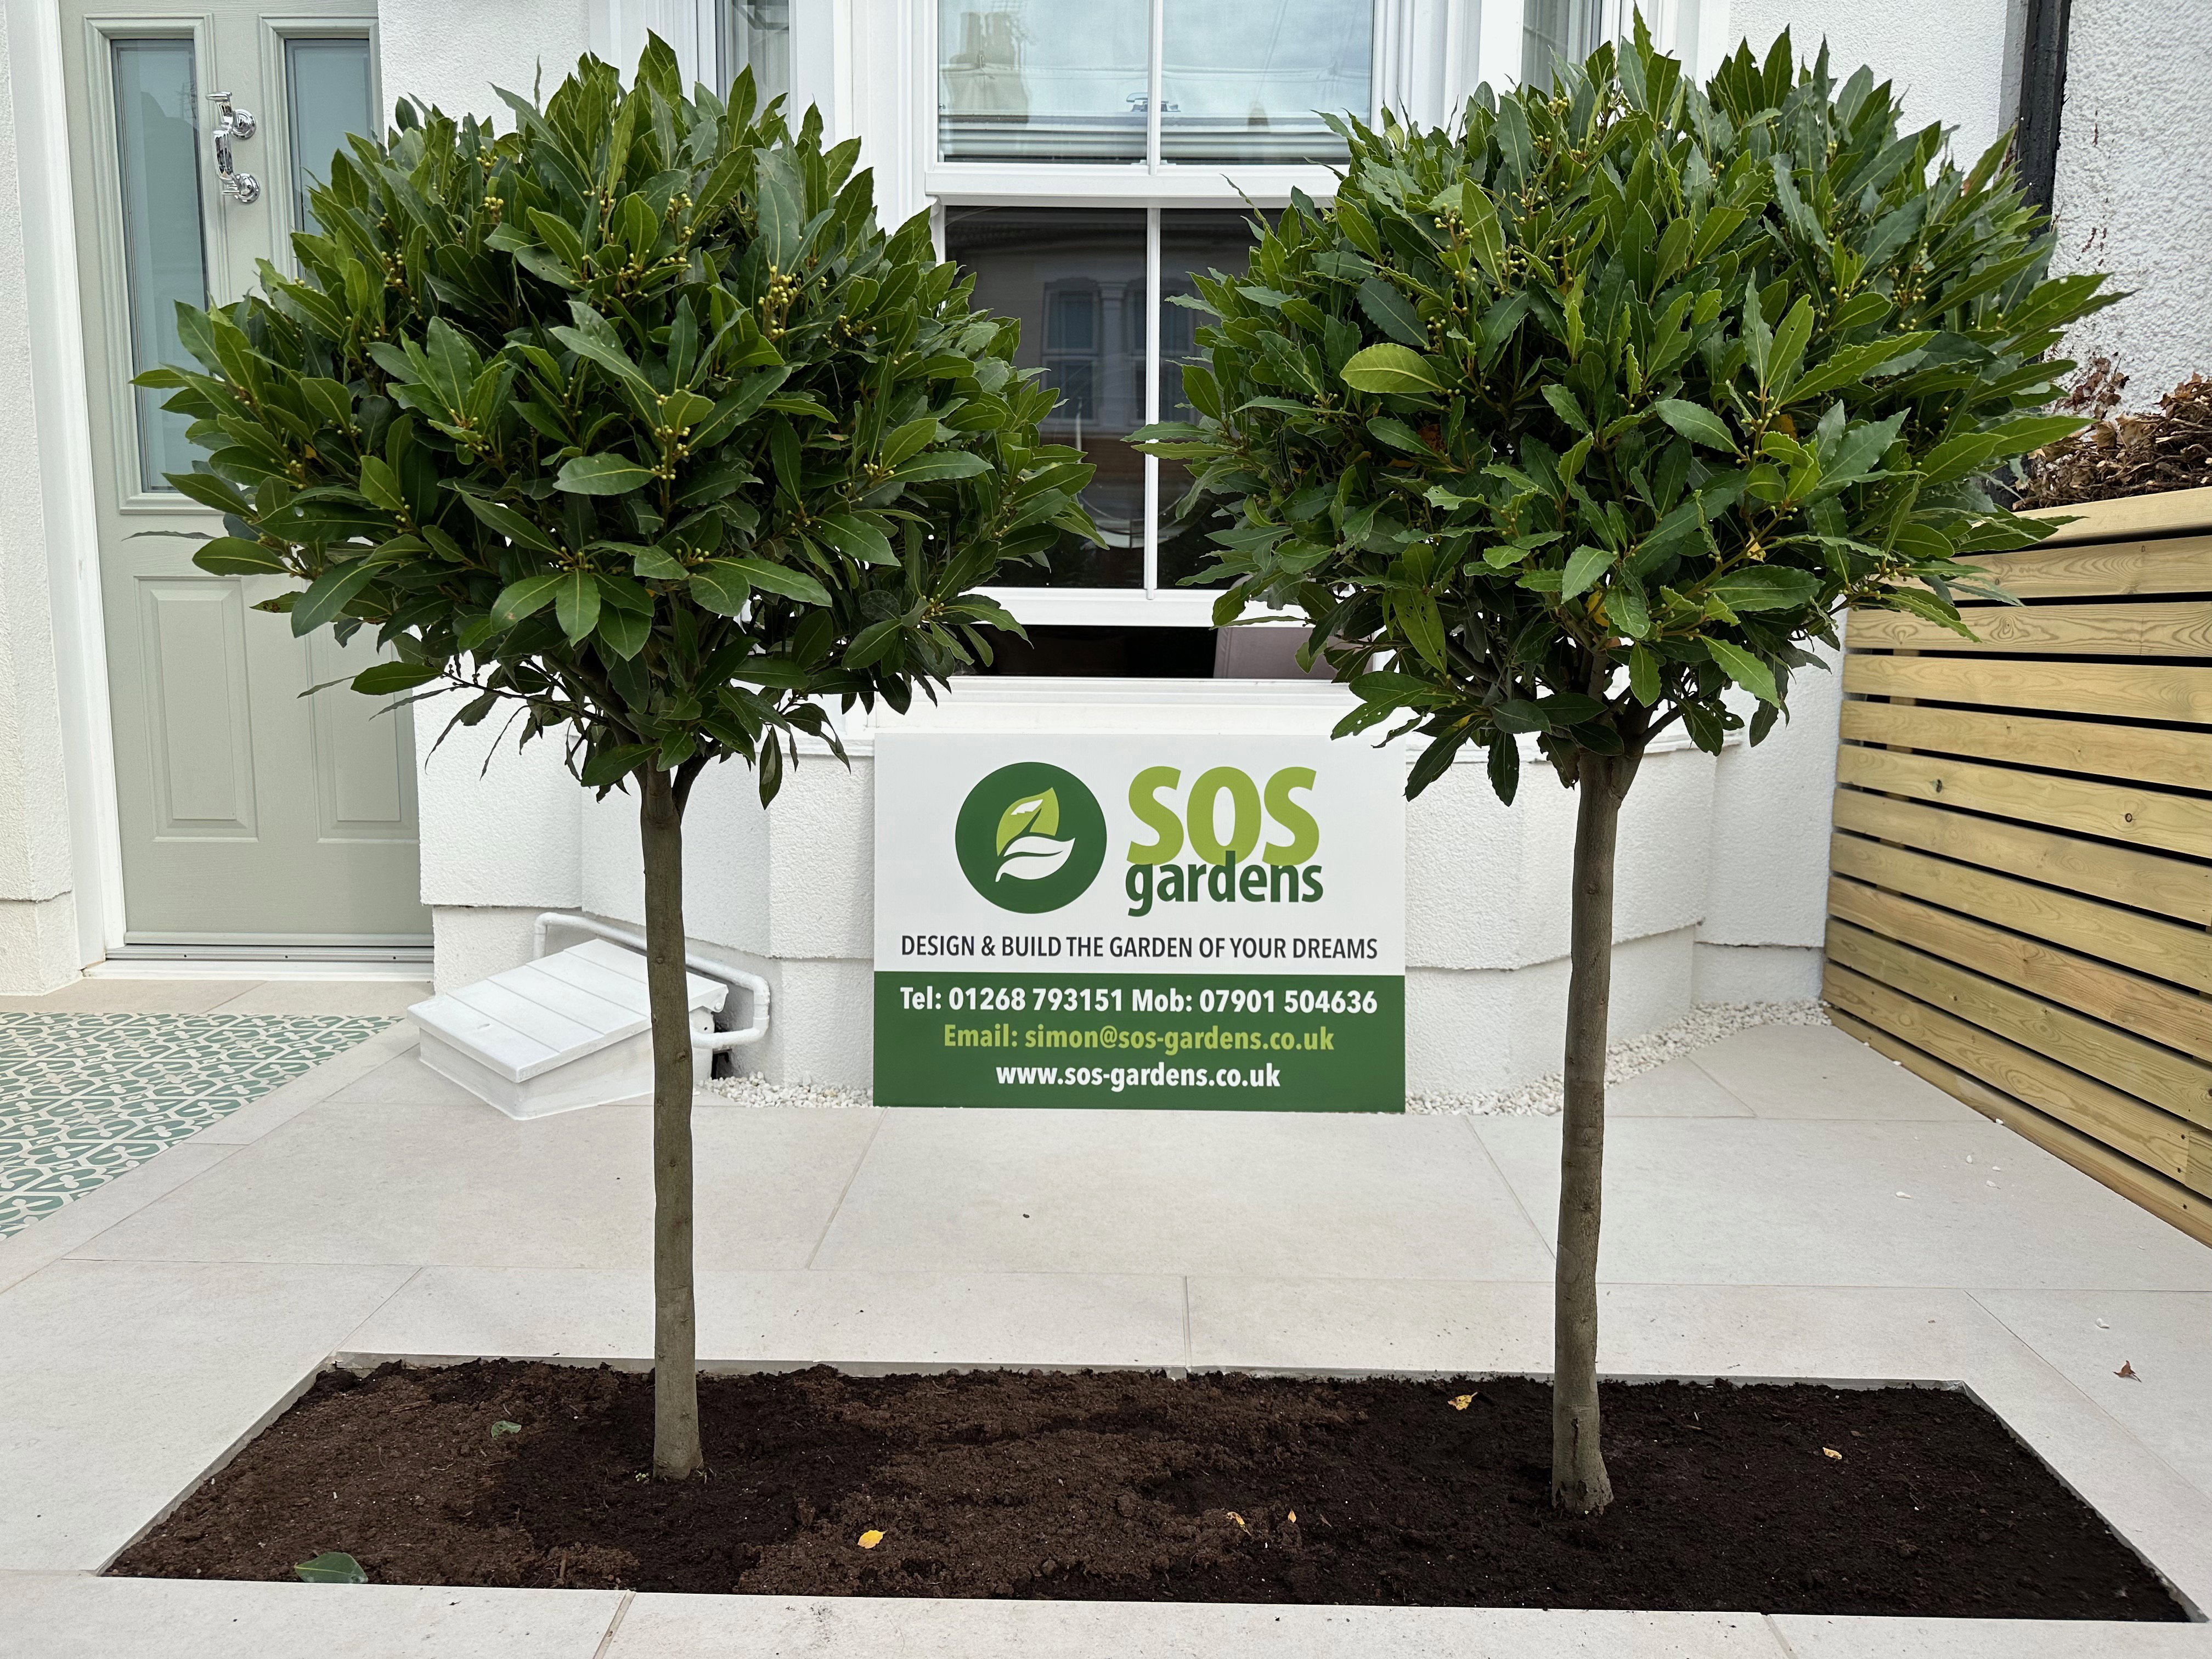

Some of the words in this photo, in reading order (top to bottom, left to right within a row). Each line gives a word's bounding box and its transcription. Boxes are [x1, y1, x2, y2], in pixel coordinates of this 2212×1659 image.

[1127, 766, 1319, 866] SOS
[1125, 850, 1323, 917] gardens
[901, 935, 974, 956] DESIGN
[981, 936, 996, 956] &
[1002, 936, 1062, 957] BUILD
[1066, 936, 1103, 957] THE
[1110, 937, 1192, 957] GARDEN
[1199, 938, 1225, 958] OF
[1229, 938, 1286, 958] YOUR
[1293, 938, 1378, 959] DREAMS
[900, 986, 941, 1010] Tel:
[949, 987, 1026, 1011] 01268
[1032, 989, 1122, 1012] 793151
[1132, 988, 1192, 1012] Mob:
[1199, 989, 1274, 1013] 07901
[1284, 990, 1378, 1014] 504636
[944, 1023, 1018, 1047] Email:
[1025, 1024, 1334, 1056] simon@sos-gardens.co.uk
[996, 1062, 1280, 1092] www.sos-gardens.co.uk
